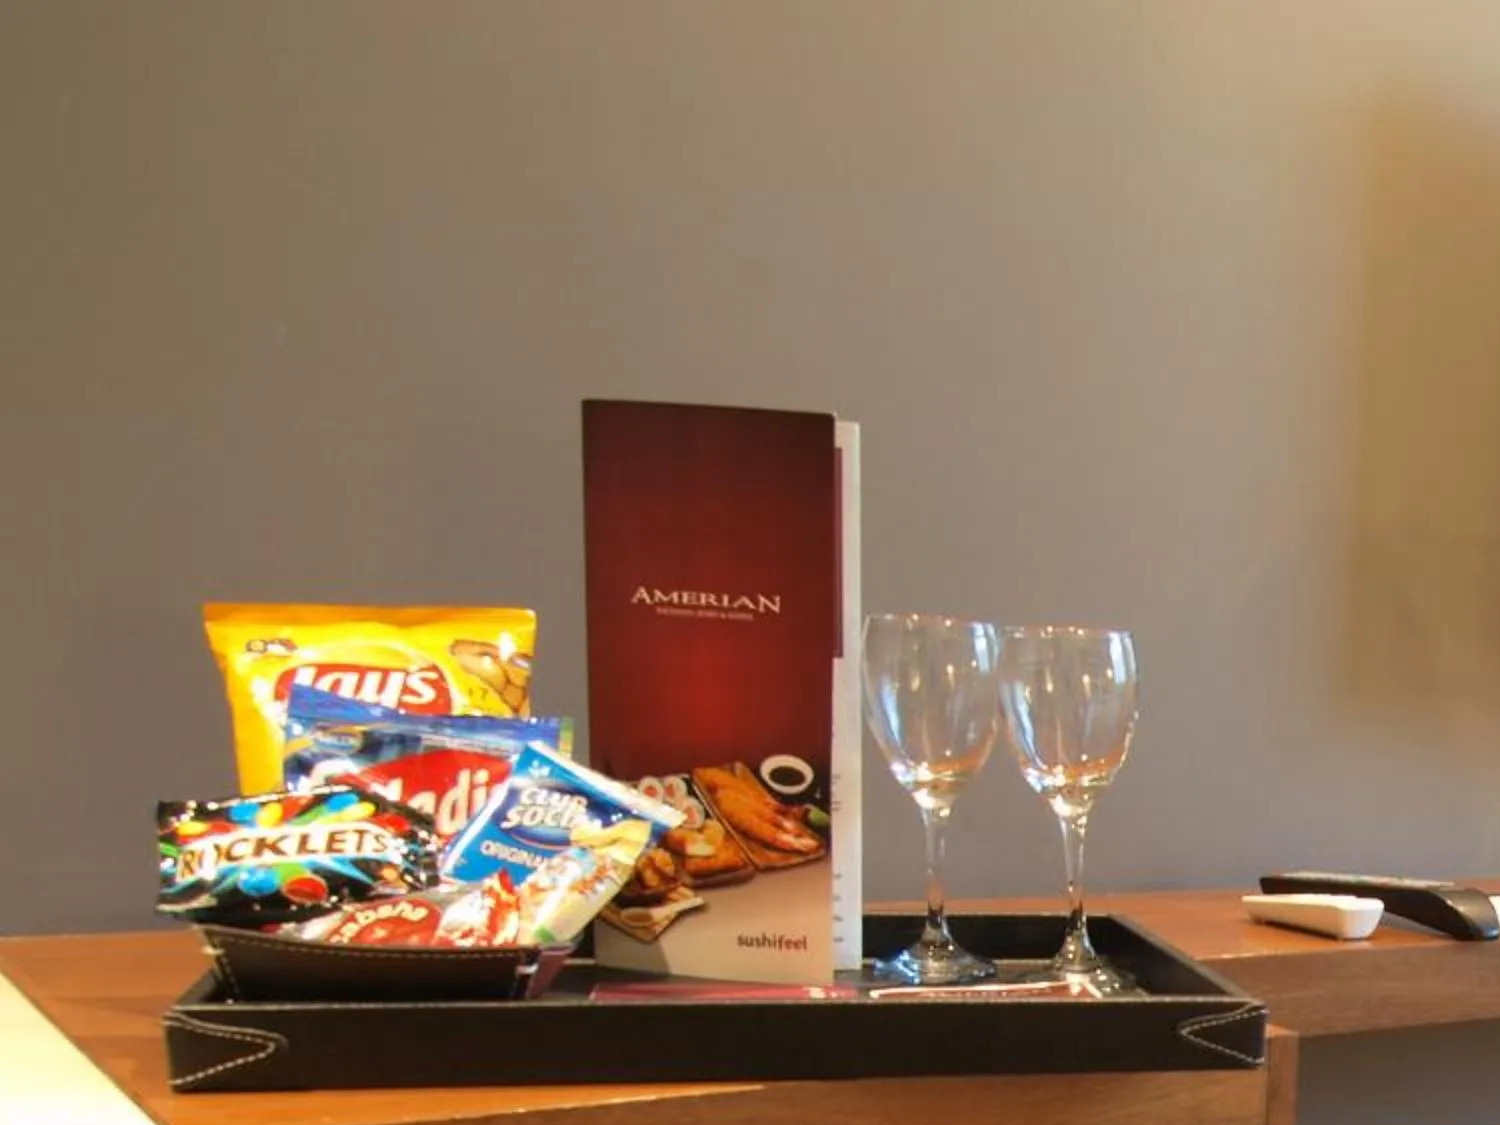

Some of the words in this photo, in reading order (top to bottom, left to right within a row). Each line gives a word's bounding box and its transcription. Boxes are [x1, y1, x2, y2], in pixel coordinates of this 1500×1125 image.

[631, 586, 781, 614] AMERIAN
[500, 803, 578, 830] SOCI
[737, 932, 808, 952] sushifeel
